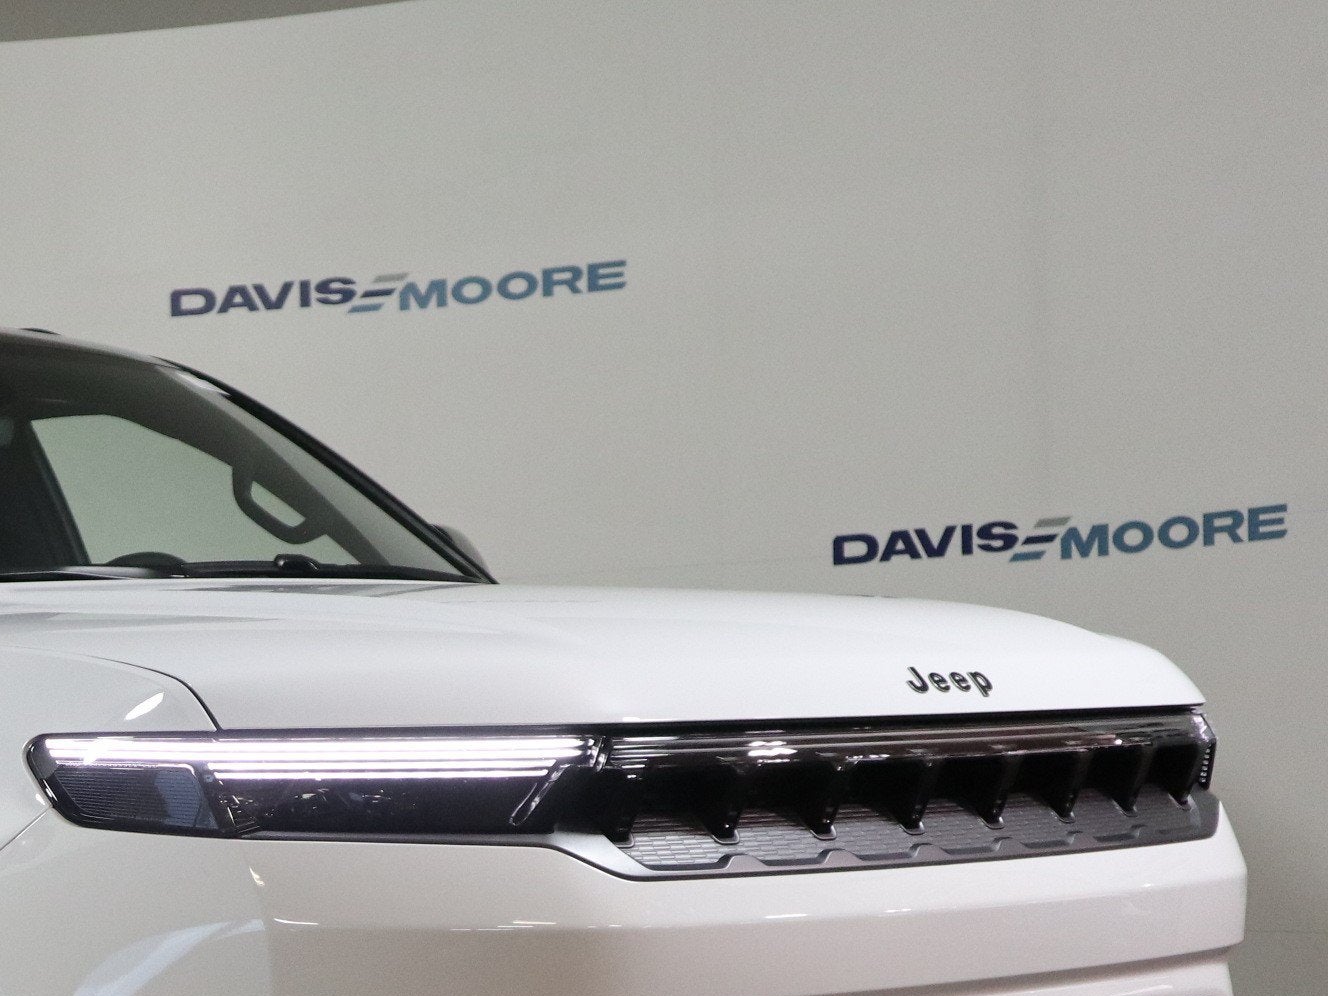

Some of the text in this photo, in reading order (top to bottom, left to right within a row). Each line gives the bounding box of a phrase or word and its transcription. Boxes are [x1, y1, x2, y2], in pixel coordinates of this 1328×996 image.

[170, 259, 626, 317] DAVIS MOORE
[833, 504, 1288, 565] DAVIS MOORE
[906, 666, 993, 697] Jeep
